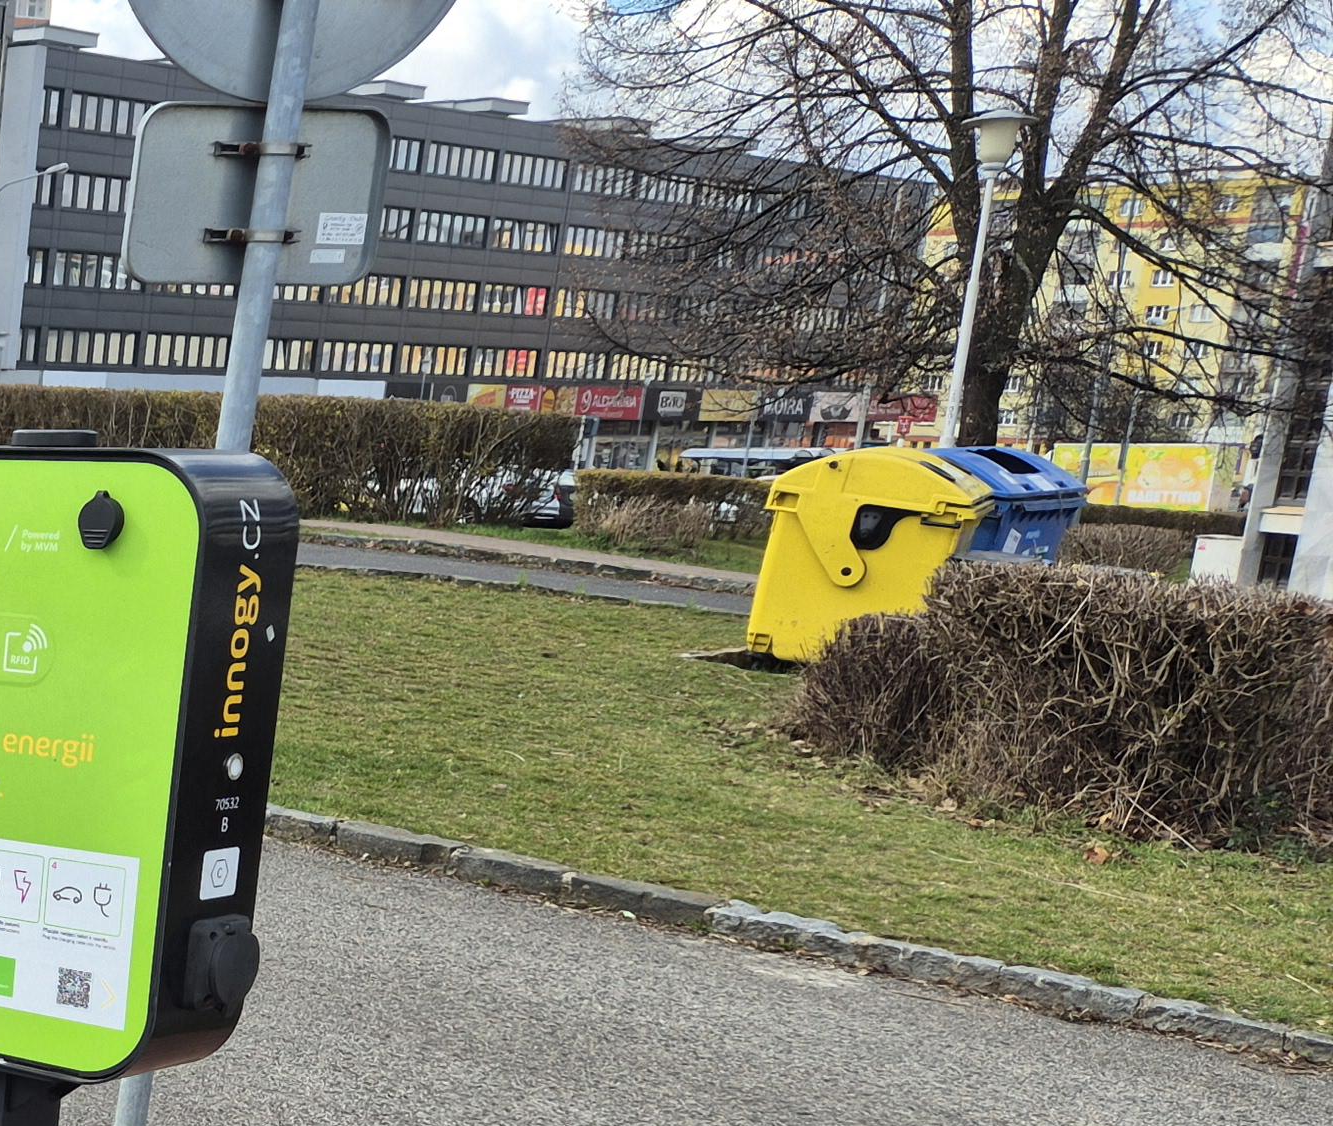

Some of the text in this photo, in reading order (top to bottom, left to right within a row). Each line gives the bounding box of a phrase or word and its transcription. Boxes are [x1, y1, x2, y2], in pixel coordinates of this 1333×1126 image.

[21, 529, 61, 541] Powered
[20, 541, 59, 552] by MVM
[10, 655, 31, 666] RFID
[2, 732, 97, 768] energii
[220, 816, 229, 833] B
